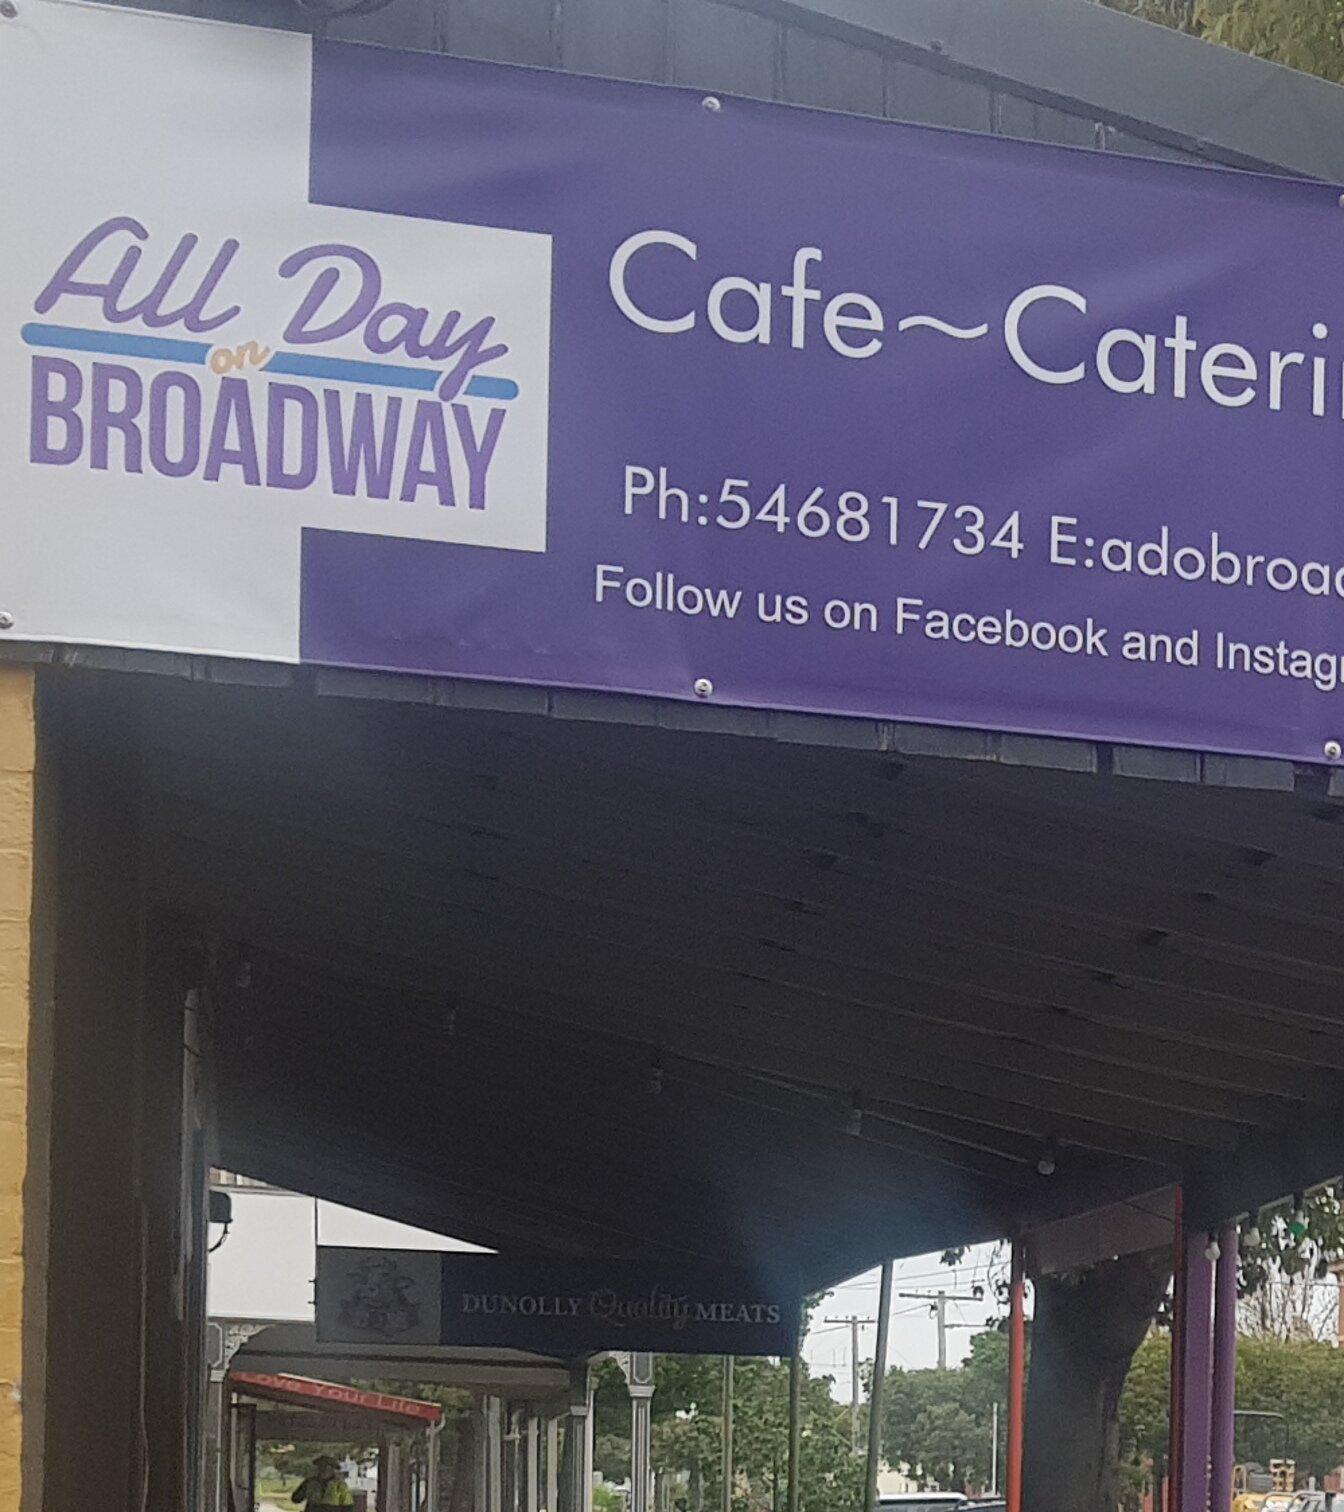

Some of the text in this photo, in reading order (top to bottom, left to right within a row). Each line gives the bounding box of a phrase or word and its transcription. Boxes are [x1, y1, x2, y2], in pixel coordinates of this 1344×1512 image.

[34, 215, 510, 401] All Day
[209, 341, 271, 375] on
[29, 354, 507, 511] BROADWAY
[623, 464, 1025, 560] Ph:54681734
[595, 563, 743, 619] Follow
[757, 591, 810, 626] us
[824, 599, 878, 632] on
[895, 597, 1110, 656] Facebook
[1121, 629, 1200, 667] and
[461, 1292, 582, 1317] DUNOLLY
[695, 1302, 781, 1325] MEATS
